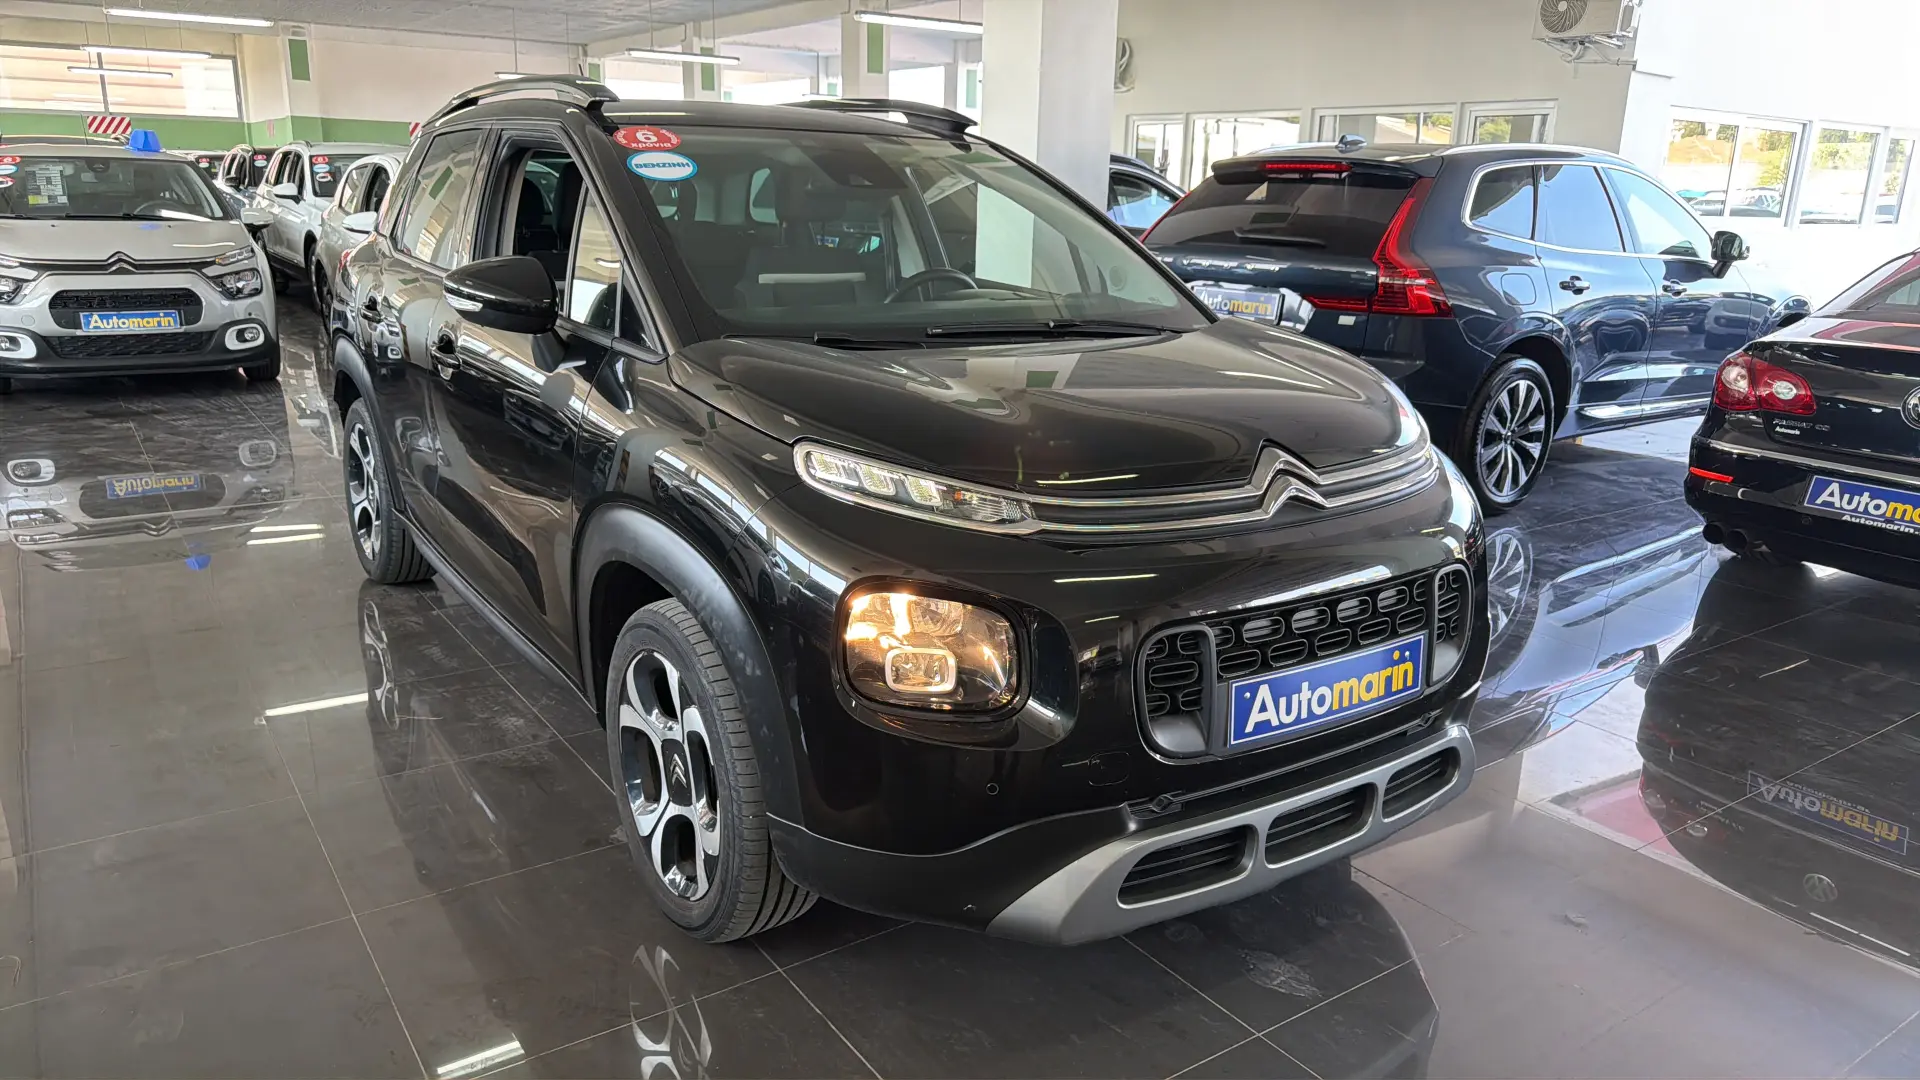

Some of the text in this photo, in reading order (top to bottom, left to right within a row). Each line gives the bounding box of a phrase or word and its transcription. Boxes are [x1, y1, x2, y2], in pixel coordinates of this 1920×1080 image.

[635, 131, 658, 143] 6
[1199, 289, 1272, 315] Automarin
[88, 312, 174, 329] Automarin
[1841, 514, 1920, 535] Automarin.
[1244, 650, 1413, 733] Automarin
